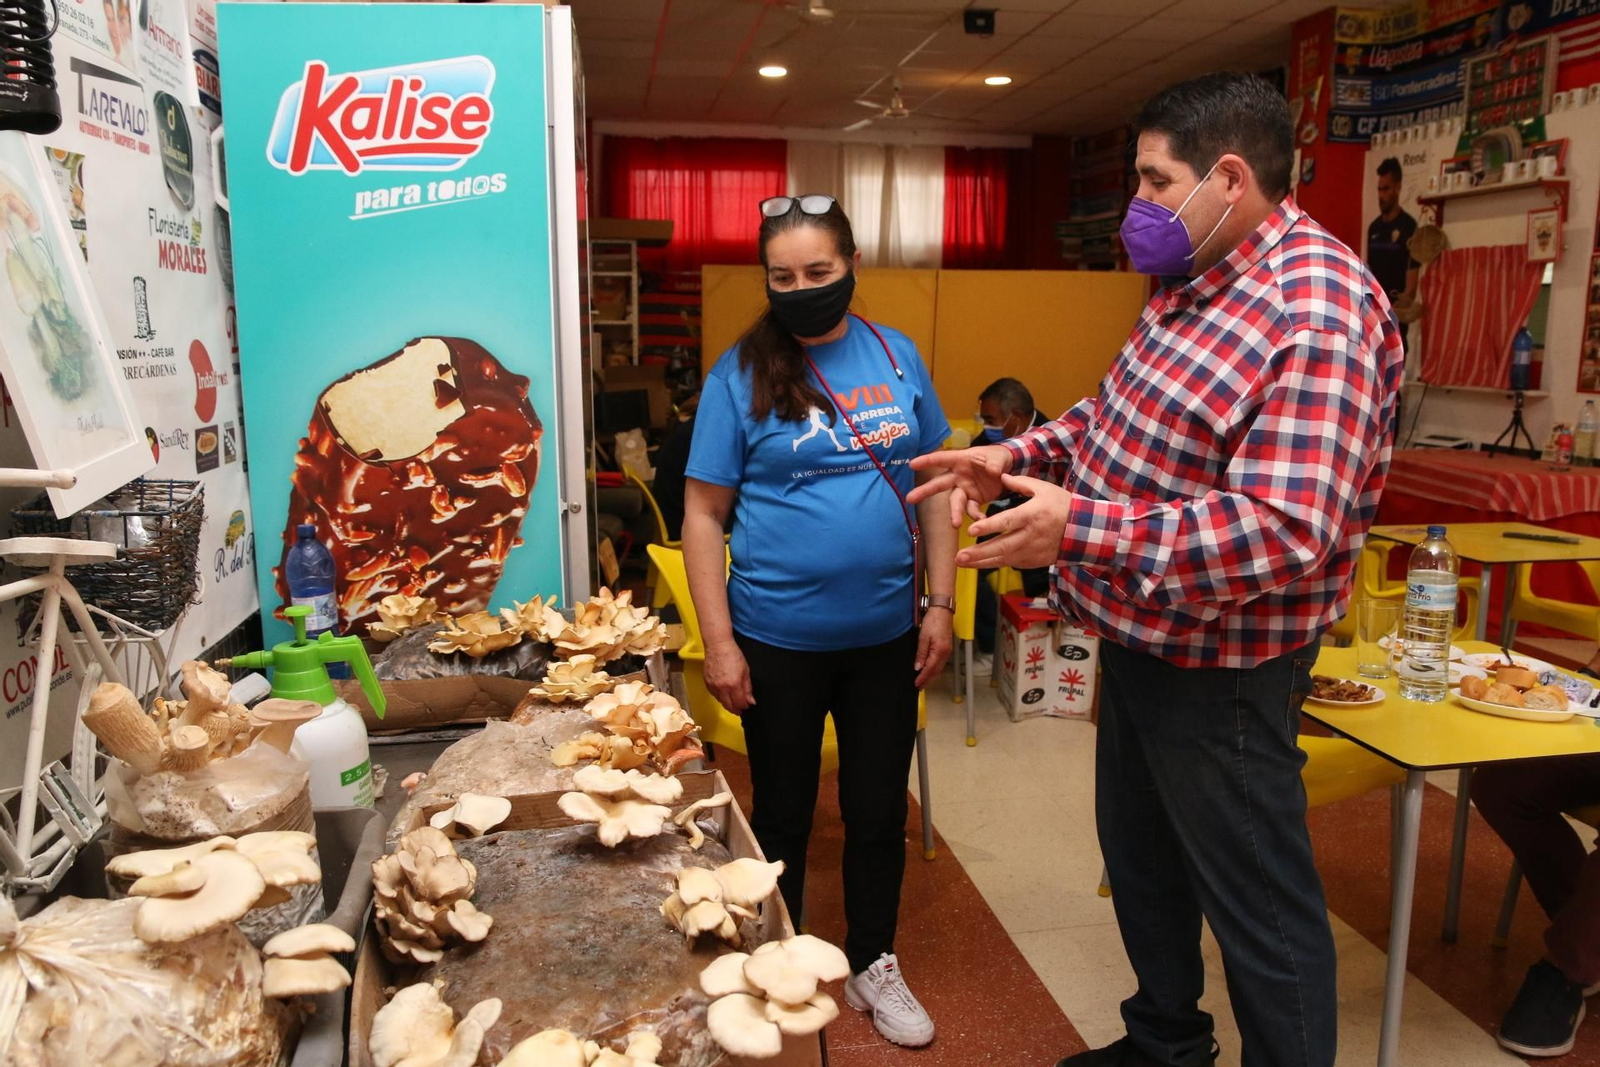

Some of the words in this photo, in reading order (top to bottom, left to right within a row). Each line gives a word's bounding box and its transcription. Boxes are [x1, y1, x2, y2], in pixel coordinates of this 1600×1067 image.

[69, 6, 77, 20] 26
[77, 12, 86, 24] 02
[59, 19, 78, 35] ranada,
[291, 64, 491, 172] Kalise
[1357, 117, 1378, 134] CF
[1403, 150, 1426, 166] René
[355, 183, 421, 215] para
[148, 207, 190, 240] Floristería
[158, 239, 208, 276] MORALES
[116, 347, 138, 360] NSIÓN
[164, 347, 175, 358] BAR
[122, 361, 177, 380] RRECÁRDENAS
[836, 384, 893, 410] VIII
[804, 467, 845, 477] IGUALDAD
[858, 462, 889, 472] NUESR
[230, 540, 246, 574] del
[1058, 686, 1085, 696] FRUPAL
